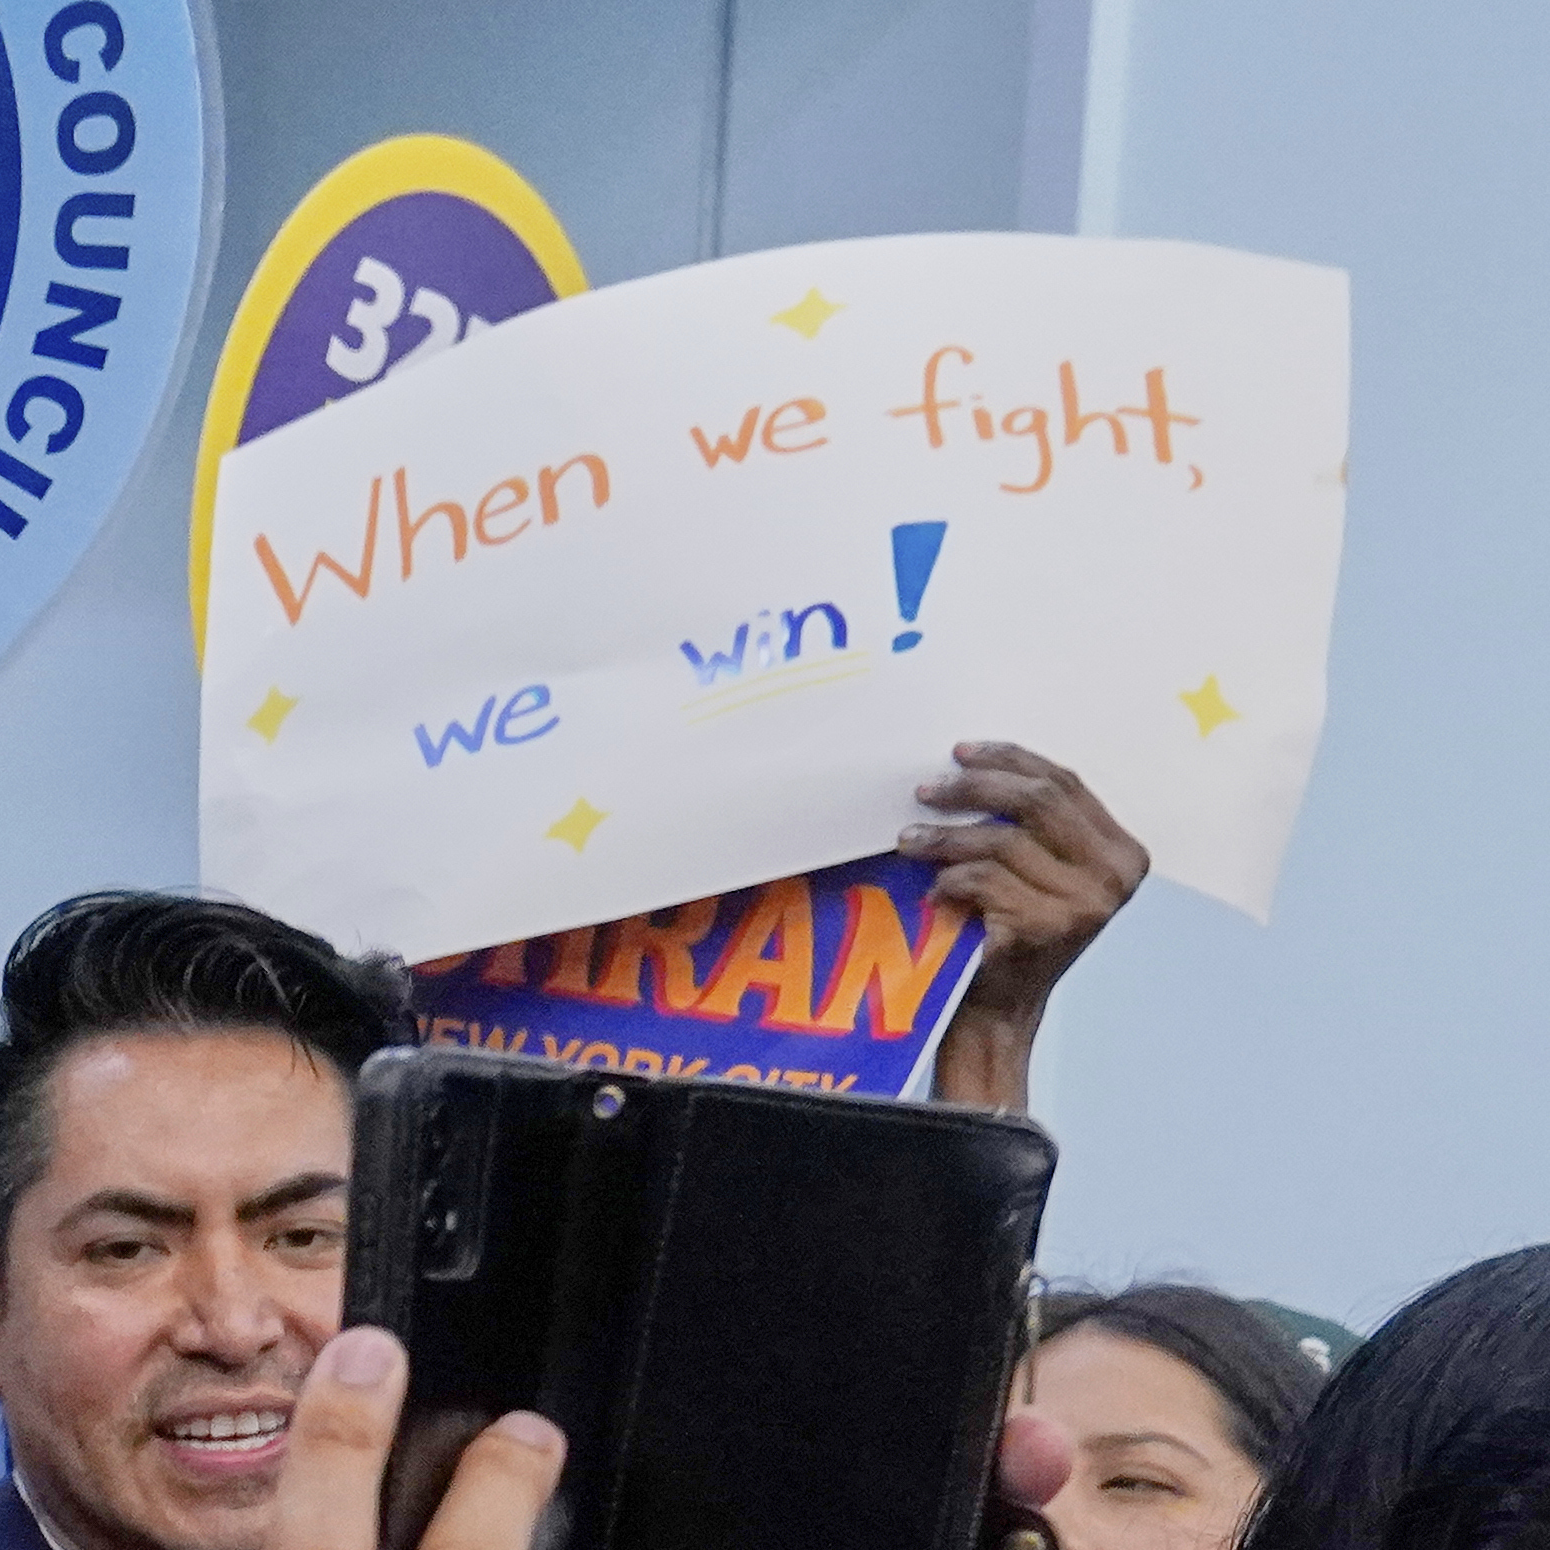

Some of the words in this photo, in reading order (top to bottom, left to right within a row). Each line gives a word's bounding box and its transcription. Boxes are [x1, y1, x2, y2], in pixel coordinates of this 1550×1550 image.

[325, 255, 493, 384] 32
[253, 450, 611, 627] When
[689, 395, 829, 470] we
[885, 344, 1206, 495] fight,
[414, 682, 562, 770] we
